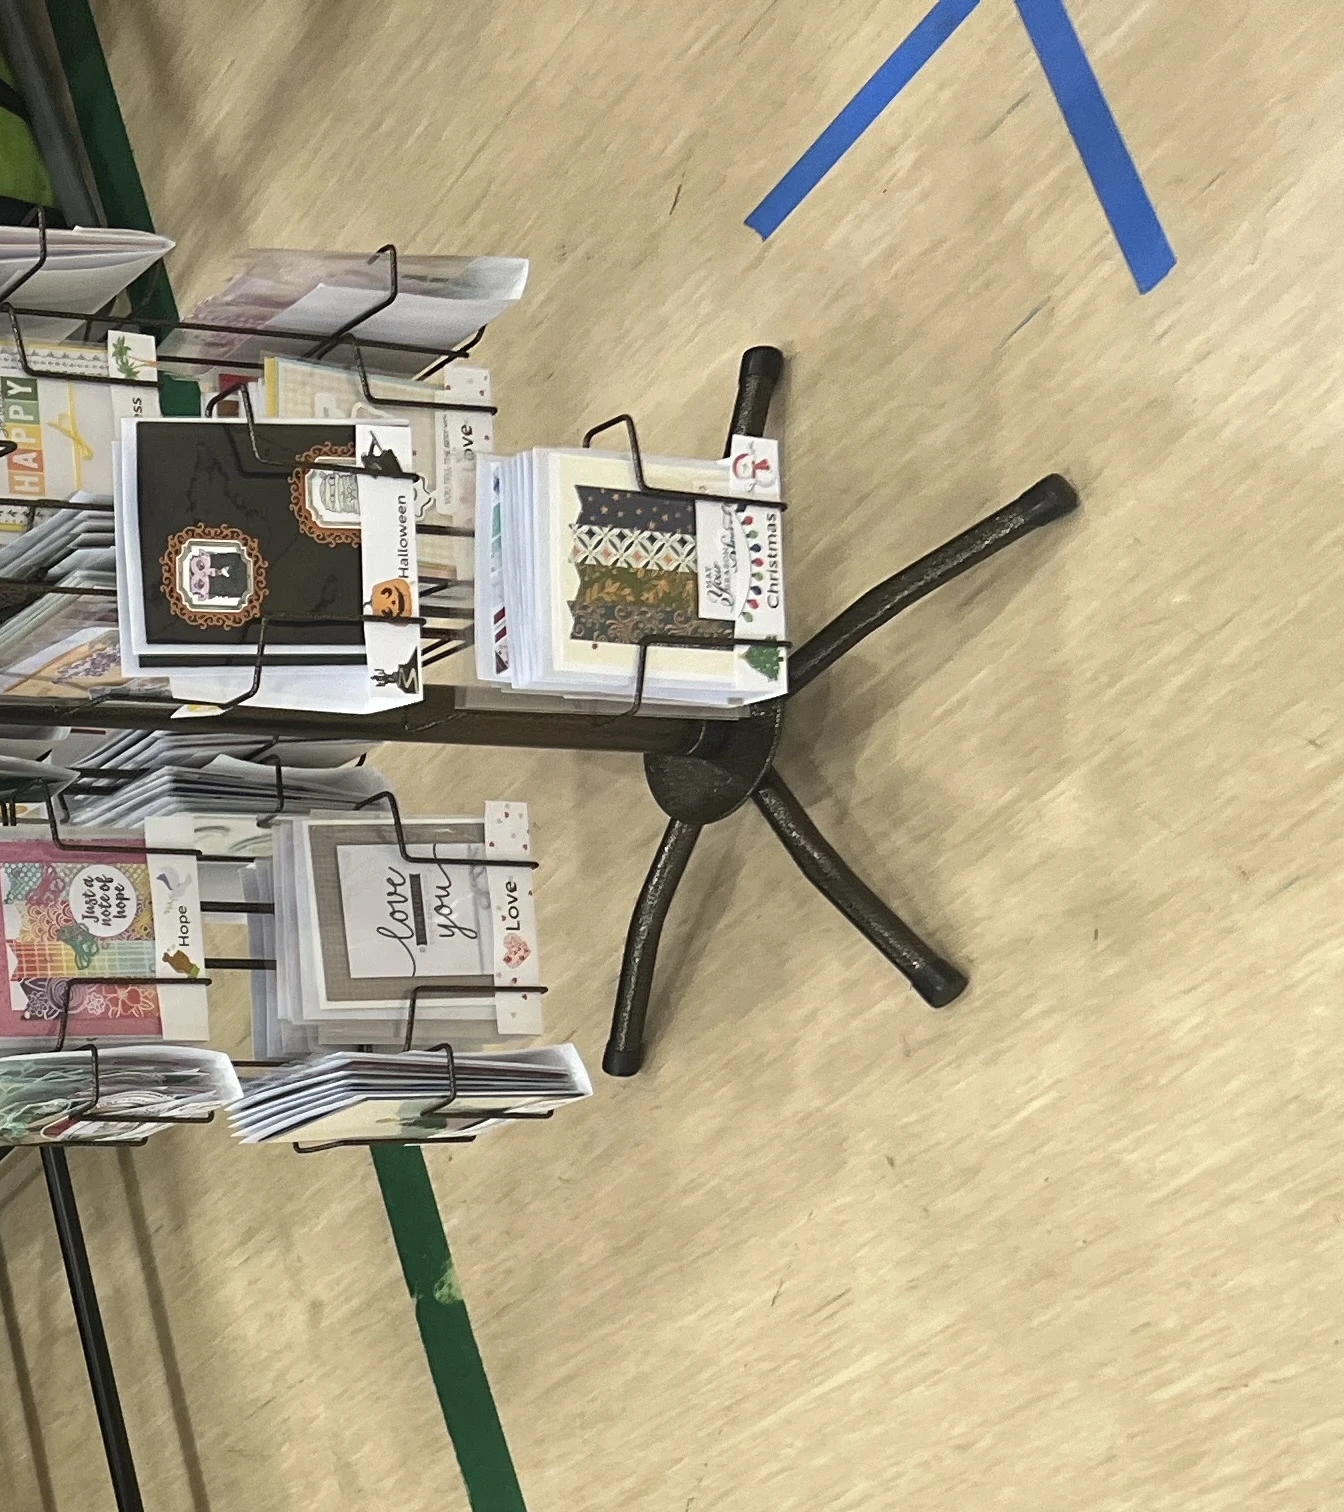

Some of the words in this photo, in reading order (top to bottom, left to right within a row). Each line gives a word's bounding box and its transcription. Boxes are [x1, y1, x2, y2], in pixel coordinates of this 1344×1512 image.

[6, 379, 40, 493] HAPPY
[395, 495, 411, 579] Halloween
[706, 561, 734, 606] Your
[766, 513, 779, 609] Christmas
[82, 875, 94, 888] a
[94, 874, 114, 892] of
[112, 882, 130, 919] hope
[433, 844, 478, 939] you
[81, 889, 99, 923] Just
[99, 892, 112, 926] note
[177, 905, 191, 947] Hope
[376, 866, 416, 977] love
[505, 881, 520, 931] Love
